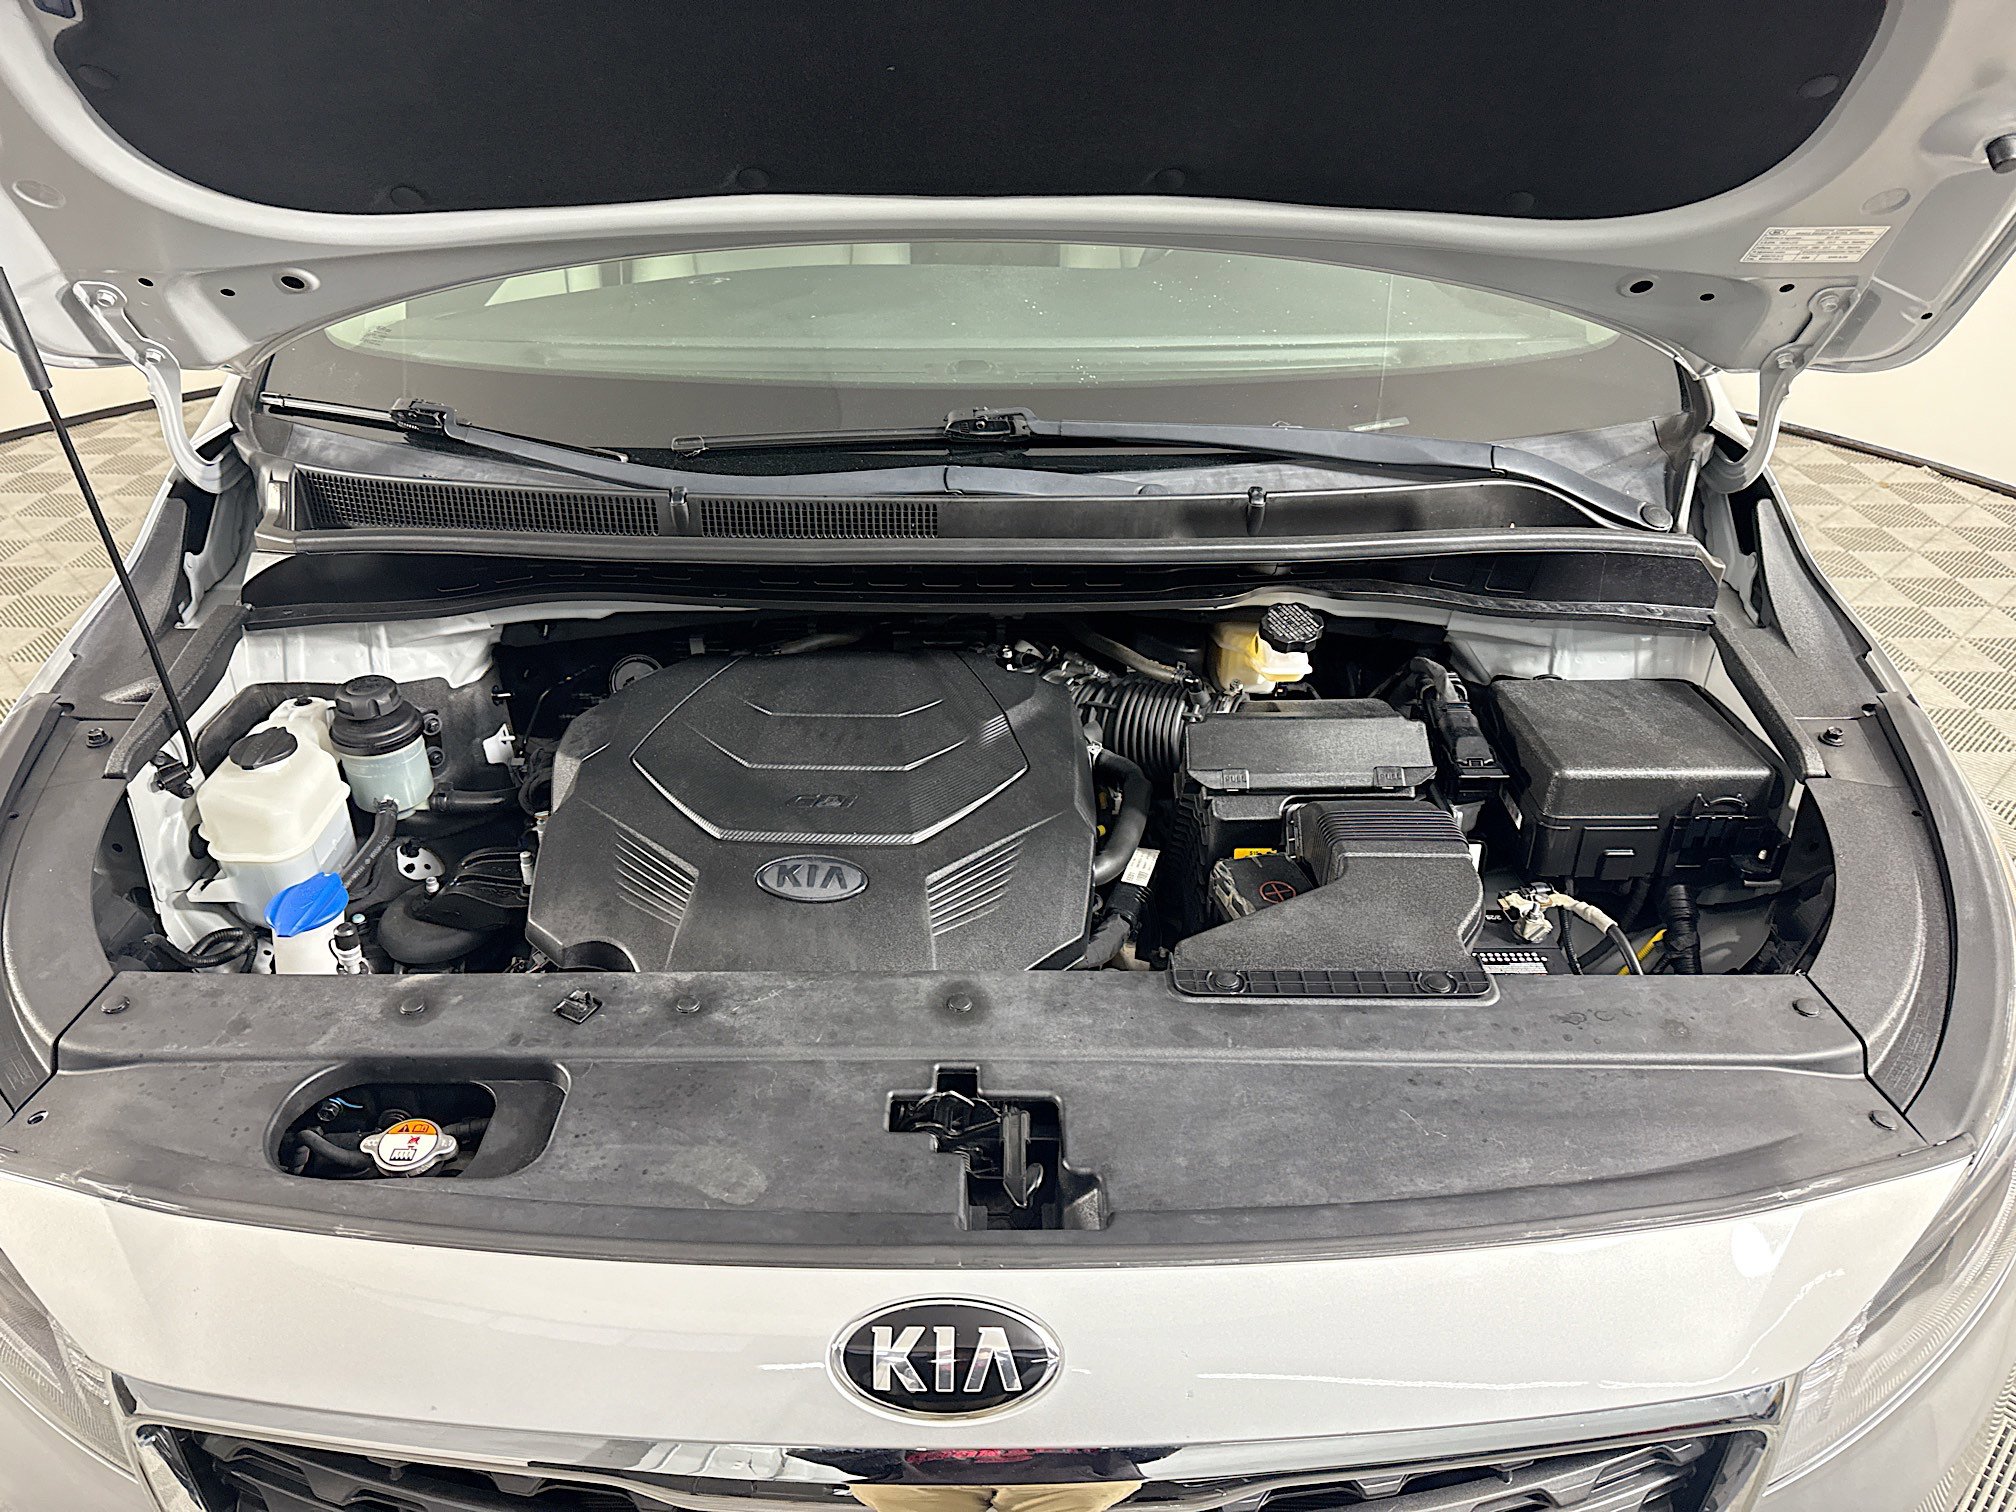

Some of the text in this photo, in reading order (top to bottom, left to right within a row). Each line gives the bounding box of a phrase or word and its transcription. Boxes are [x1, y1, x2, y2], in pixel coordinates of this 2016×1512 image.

[1224, 774, 1247, 784] PULL
[1379, 772, 1402, 781] PULL
[775, 863, 848, 890] KIA
[870, 1325, 1024, 1394] KIA
